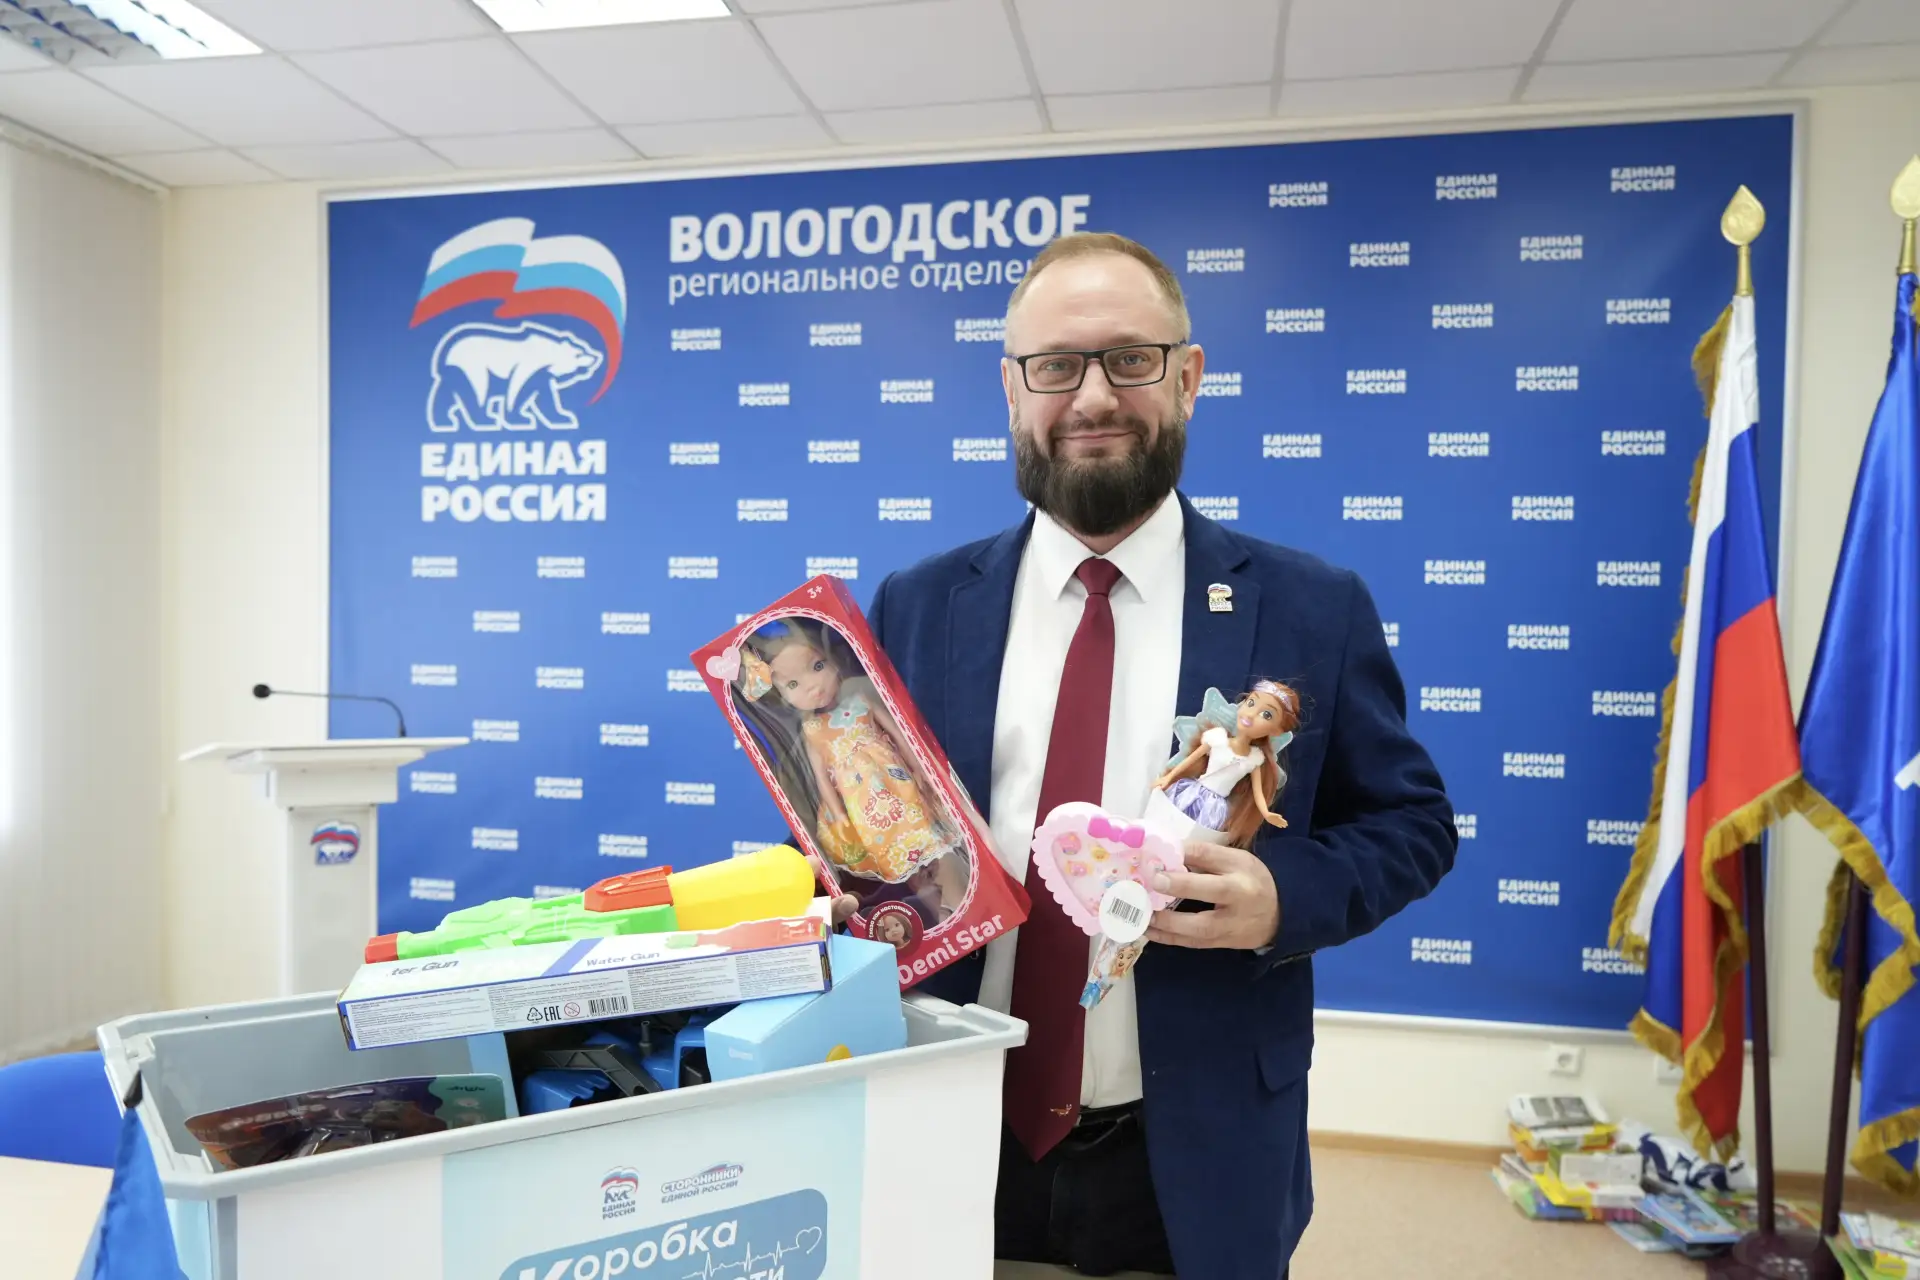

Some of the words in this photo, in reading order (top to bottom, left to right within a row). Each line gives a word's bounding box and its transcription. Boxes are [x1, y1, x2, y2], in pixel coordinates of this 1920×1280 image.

[1611, 165, 1676, 180] ЕДИНАЯ
[1436, 173, 1498, 188] ЕДИНАЯ
[1611, 177, 1676, 193] РОССИЯ
[1269, 181, 1328, 196] ЕДИНАЯ
[1436, 185, 1498, 200] РОССИЯ
[1269, 193, 1328, 208] РОССИЯ
[670, 194, 1091, 263] ВОЛОГОДСКОЕ
[1520, 234, 1583, 249] ЕДИНАЯ
[1187, 248, 1245, 262] ЕДИНАЯ
[1349, 241, 1410, 256] ЕДИНАЯ
[1520, 246, 1583, 261] РОССИЯ
[1187, 259, 1245, 273] РОССИЯ
[1349, 253, 1410, 267] РОССИЯ
[669, 264, 899, 305] региональное
[1432, 303, 1494, 316] ЕДИНАЯ
[1606, 298, 1671, 311] ЕДИНАЯ
[1266, 308, 1325, 322] ЕДИНАЯ
[1606, 310, 1671, 324] РОССИЯ
[809, 322, 862, 336] ЕДИНАЯ
[1266, 319, 1325, 333] РОССИЯ
[1432, 316, 1494, 329] РОССИЯ
[671, 327, 721, 341] ЕДИНАЯ
[809, 333, 862, 346] РОССИЯ
[671, 338, 721, 351] РОССИЯ
[1346, 369, 1407, 382] ЕДИНАЯ
[1516, 365, 1579, 378] ЕДИНАЯ
[738, 382, 790, 396] ЕДИНАЯ
[880, 379, 934, 393] ЕДИНАЯ
[1346, 382, 1407, 394] РОССИЯ
[1516, 378, 1579, 391] РОССИЯ
[738, 393, 790, 407] РОССИЯ
[880, 390, 934, 403] РОССИЯ
[1263, 433, 1322, 446] ЕДИНАЯ
[1428, 432, 1490, 444] ЕДИНАЯ
[1601, 430, 1666, 442] ЕДИНАЯ
[669, 442, 720, 454] ЕДИНАЯ
[807, 439, 860, 452] ЕДИНАЯ
[953, 438, 1007, 450] ЕДИНАЯ
[1428, 444, 1490, 457] РОССИЯ
[1601, 442, 1666, 456] РОССИЯ
[807, 452, 860, 463] РОССИЯ
[953, 450, 1007, 461] РОССИЯ
[1263, 446, 1322, 458] РОССИЯ
[421, 440, 607, 481] ЕДИНАЯ
[669, 454, 720, 465] РОССИЯ
[421, 484, 607, 522] РОССИЯ
[736, 498, 788, 510] ЕДИНАЯ
[878, 497, 932, 510] ЕДИНАЯ
[1343, 496, 1403, 508] ЕДИНАЯ
[1511, 495, 1575, 508] ЕДИНАЯ
[736, 510, 788, 522] РОССИЯ
[878, 510, 932, 521] РОССИЯ
[1343, 508, 1403, 521] РОССИЯ
[1511, 508, 1575, 521] РОССИЯ
[807, 557, 859, 568] ЕДИНАЯ
[1424, 559, 1486, 572] ЕДИНАЯ
[1596, 561, 1661, 574] ЕДИНАЯ
[1424, 572, 1486, 585] РОССИЯ
[1596, 574, 1661, 587] РОССИЯ
[807, 585, 823, 599] 3+
[1507, 624, 1570, 636] ЕДИНАЯ
[1507, 636, 1570, 650] РОССИЯ
[1420, 686, 1482, 700] ЕДИНАЯ
[1592, 691, 1656, 704] ЕДИНАЯ
[1420, 700, 1482, 712] РОССИЯ
[1592, 704, 1656, 717] РОССИЯ
[1503, 752, 1566, 764] ЕДИНАЯ
[1503, 764, 1566, 779] РОССИЯ
[1587, 832, 1639, 846] РОССИ
[1498, 879, 1560, 894] ЕДИНАЯ
[1498, 891, 1560, 906] РОССИЯ
[898, 937, 958, 985] Demi
[956, 914, 1004, 951] Star
[1411, 937, 1473, 952] ЕДИНАЯ
[587, 956, 626, 967] Water
[630, 952, 660, 962] Gun
[1411, 949, 1473, 965] РОССИЯ
[422, 960, 459, 971] Gun
[661, 1166, 739, 1194] СТОРОННИКИ
[662, 1188, 699, 1204] ЕДИНОЙ
[702, 1180, 739, 1195] РОССИИ
[602, 1200, 636, 1213] ЕДИНАЯ
[602, 1207, 636, 1220] РОССИЯ
